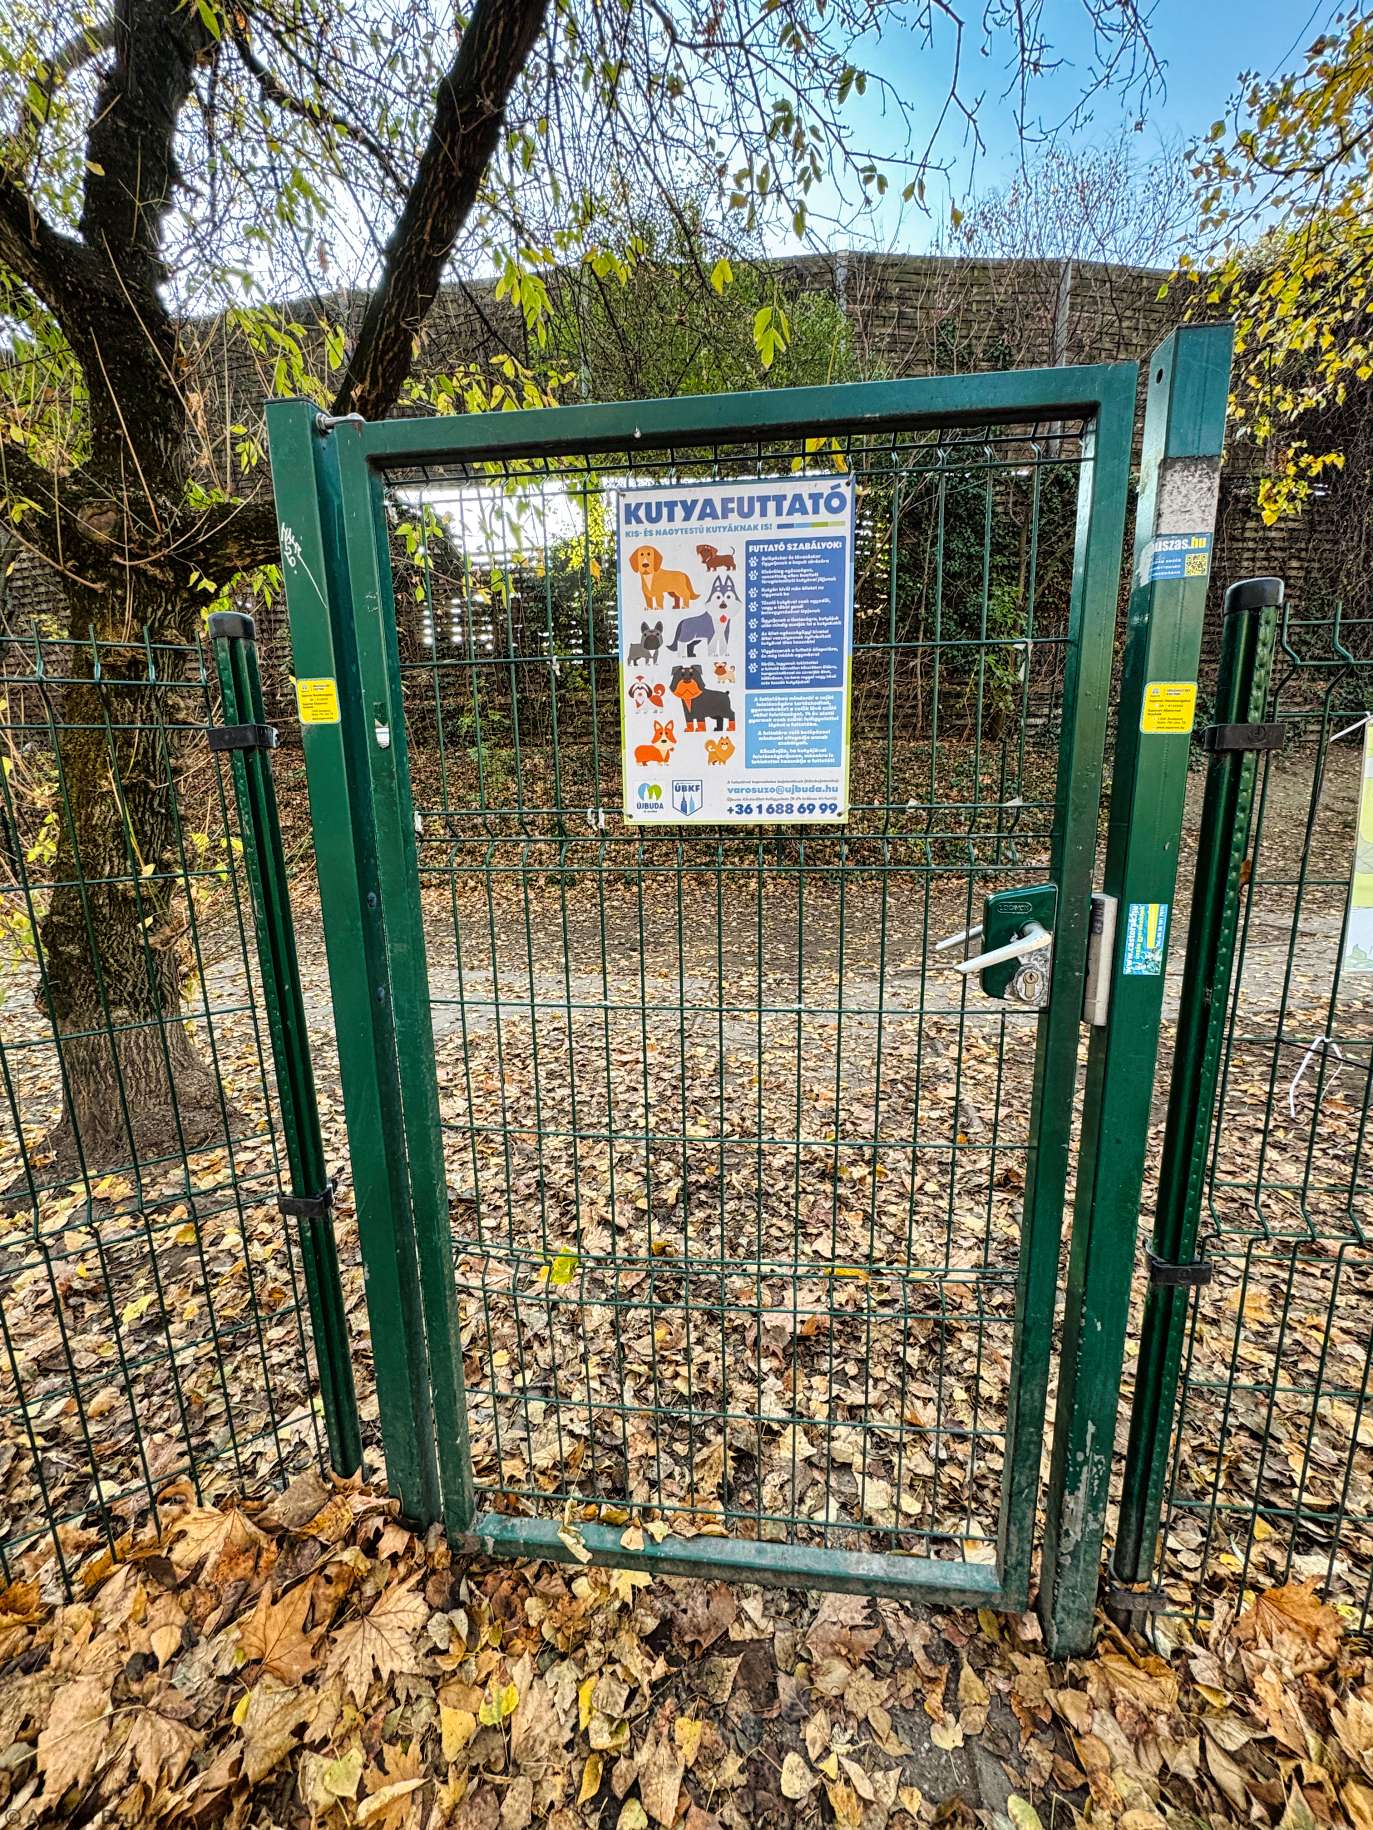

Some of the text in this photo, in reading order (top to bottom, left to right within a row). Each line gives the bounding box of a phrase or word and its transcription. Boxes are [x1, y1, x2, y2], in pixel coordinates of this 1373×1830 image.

[624, 483, 848, 525] KUTYAFUTTATÓ
[625, 530, 642, 538] KIS-
[643, 528, 653, 537] ÉS
[705, 524, 759, 535] KUTYÁKNAK
[749, 540, 843, 552] FUTTATÓ SZABÁLYOK:
[1154, 536, 1207, 552] uszas.hu
[727, 803, 838, 815] +36 1 688 69 99
